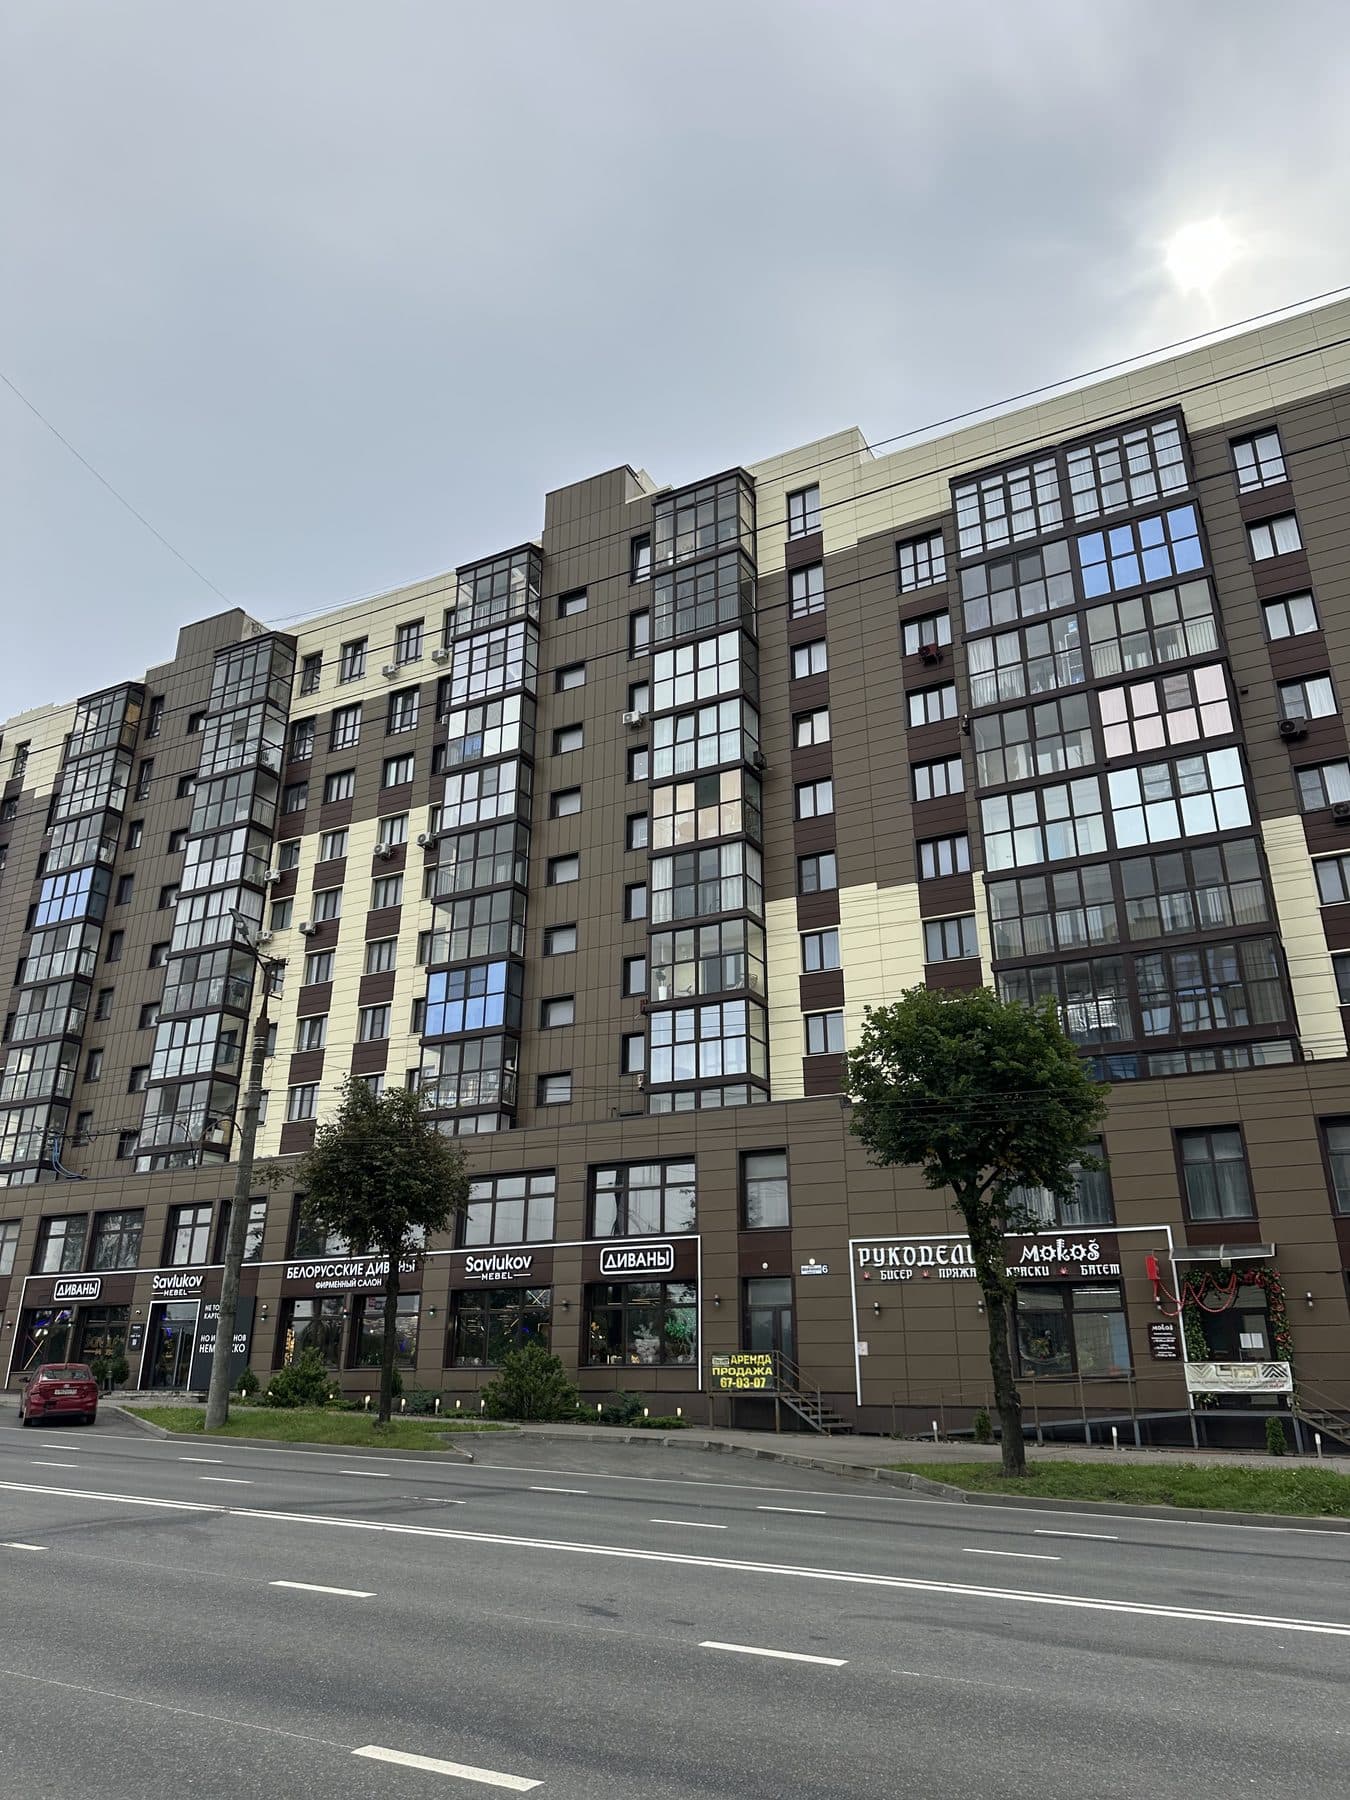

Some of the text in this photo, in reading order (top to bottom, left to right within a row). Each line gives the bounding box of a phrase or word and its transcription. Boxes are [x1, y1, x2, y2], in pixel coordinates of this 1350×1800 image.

[465, 1253, 532, 1273] Savlukov
[604, 1253, 670, 1269] ДИВАНЫ
[858, 1244, 977, 1267] РУКОДЕЛ
[286, 1259, 416, 1279] БЕЛОРУССКИЕ ДИВНЫ
[822, 1264, 829, 1274] 6
[880, 1269, 913, 1280] БИСЕР
[938, 1267, 977, 1279] ПРЯЖА
[1005, 1265, 1050, 1277] КРАСКИ
[152, 1273, 203, 1289] Savlukov
[315, 1277, 382, 1289] ФИРМЕННЫЙ САЛОН
[56, 1282, 98, 1297] ДИВАНЫ
[730, 1354, 772, 1366] АРЕНДА
[712, 1367, 773, 1377] ПРОДАЖА
[720, 1377, 767, 1388] 67-03-07
